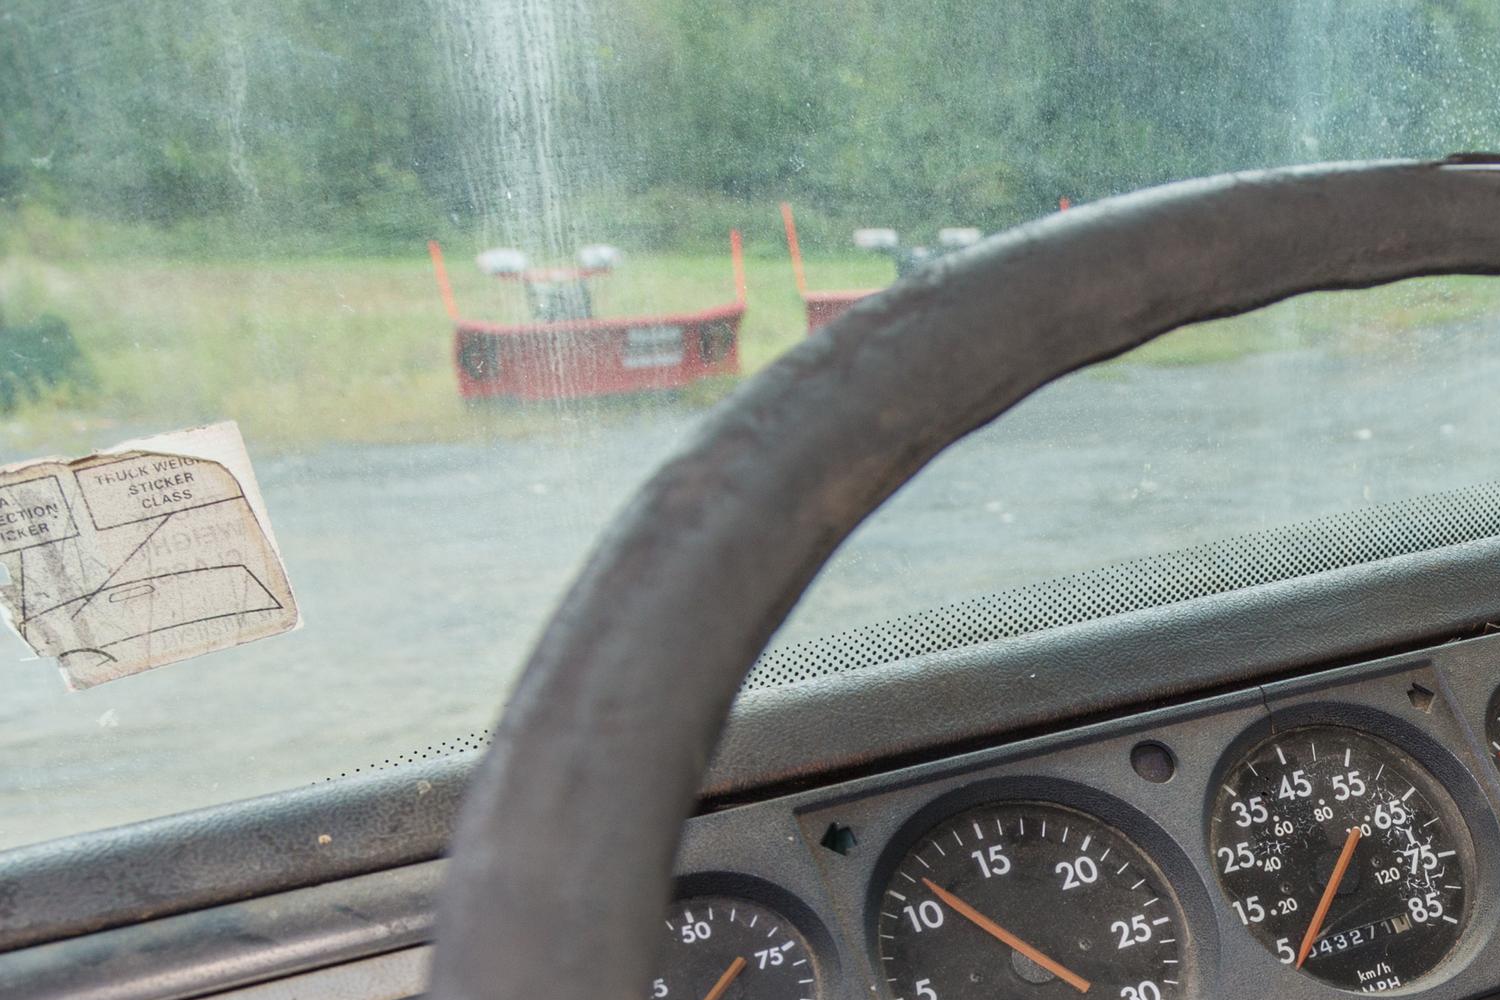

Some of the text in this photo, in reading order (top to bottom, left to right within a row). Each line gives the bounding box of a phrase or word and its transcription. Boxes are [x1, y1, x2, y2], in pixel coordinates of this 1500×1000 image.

[94, 456, 200, 486] TRUCK WEIG
[128, 472, 195, 496] STICKER
[142, 489, 193, 509] CLASS
[1277, 770, 1312, 801] 45
[1332, 771, 1366, 801] 55
[1231, 797, 1268, 827] 35
[1313, 806, 1333, 822] 80
[1374, 800, 1407, 829] 65
[1274, 820, 1294, 837] 60
[971, 844, 1011, 878] 15
[1217, 842, 1255, 874] 25
[1263, 856, 1282, 873] 40
[1404, 844, 1438, 875] 75
[1055, 856, 1097, 890] 20
[1374, 867, 1400, 885] 120
[903, 900, 944, 932] 10
[1232, 896, 1265, 925] 15
[1278, 898, 1298, 915] 20
[1408, 892, 1443, 923] 85
[681, 922, 712, 944] 50
[1110, 914, 1152, 949] 25
[754, 947, 784, 969] 75
[1276, 938, 1296, 964] 5
[1357, 962, 1392, 981] km/h
[651, 979, 668, 998] 5
